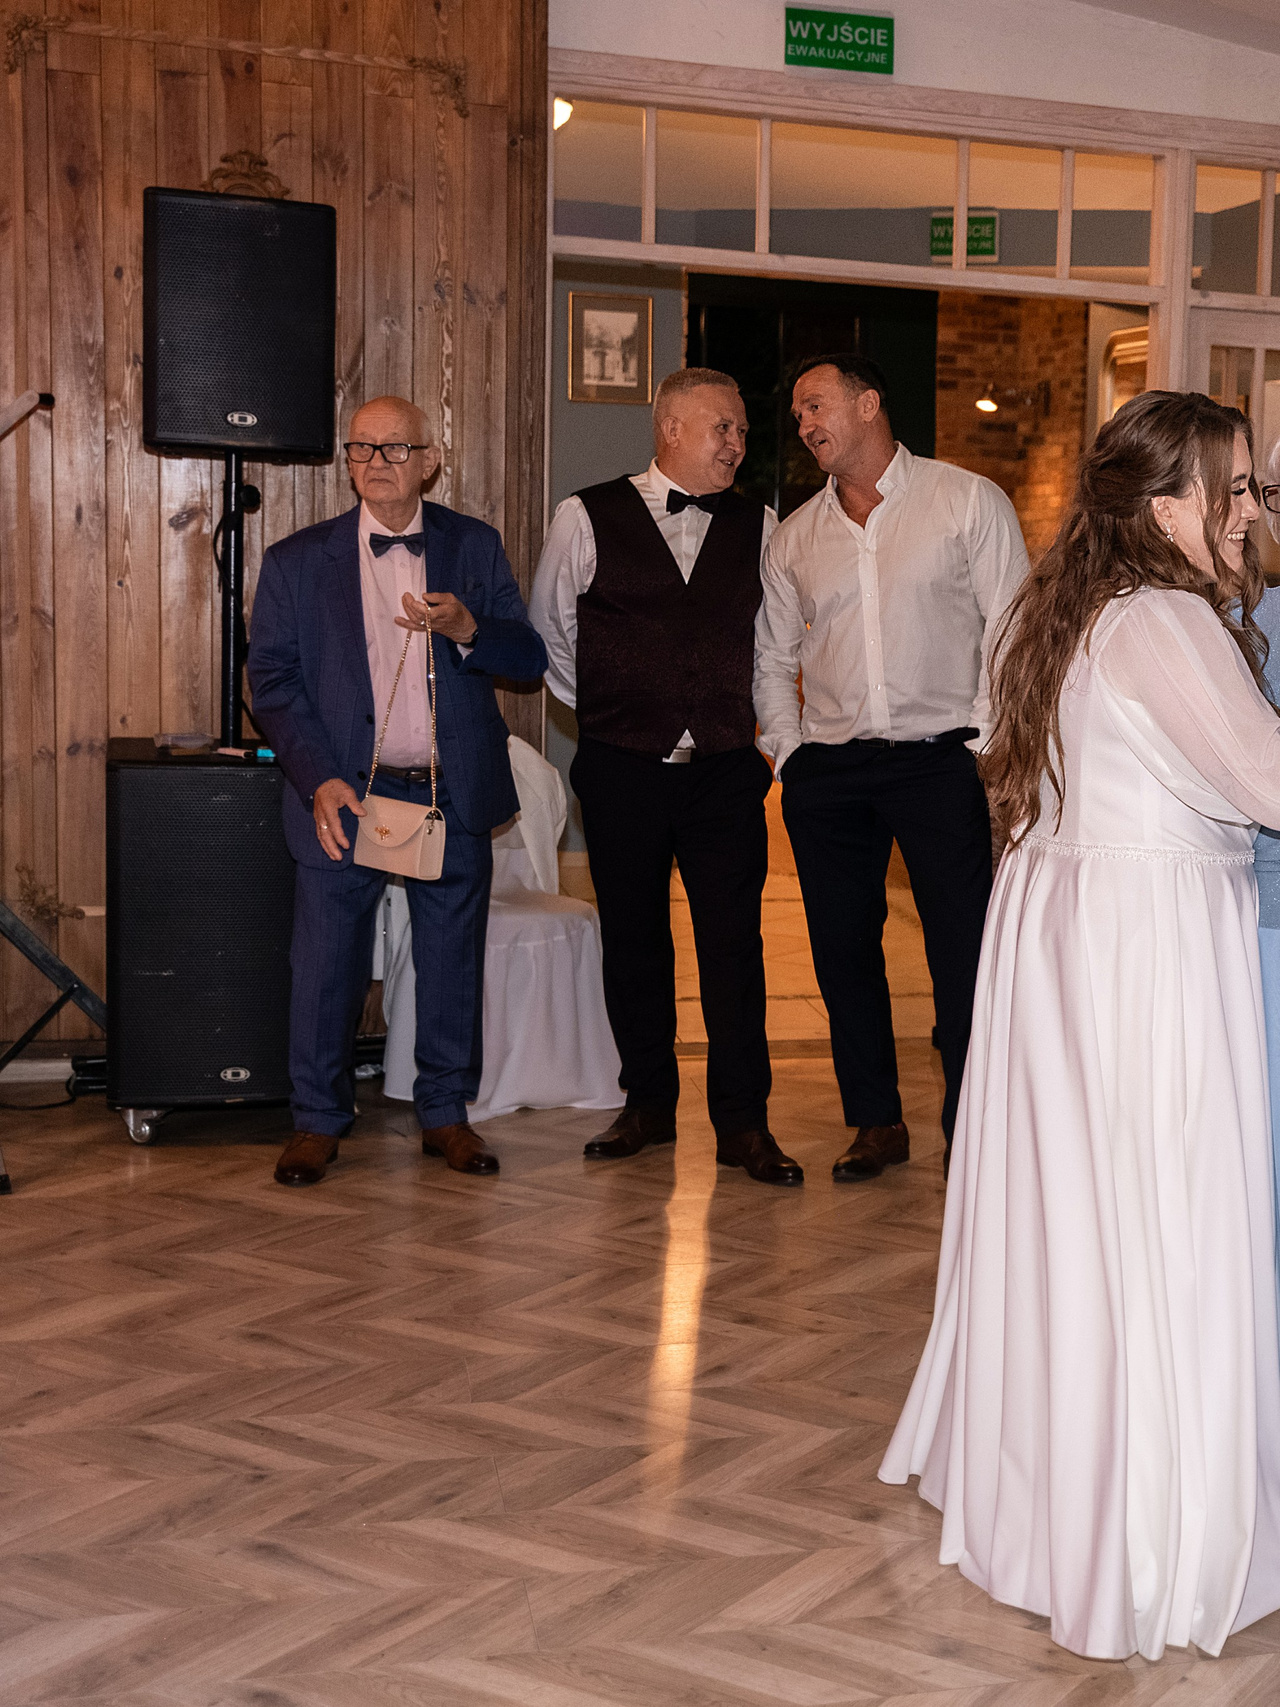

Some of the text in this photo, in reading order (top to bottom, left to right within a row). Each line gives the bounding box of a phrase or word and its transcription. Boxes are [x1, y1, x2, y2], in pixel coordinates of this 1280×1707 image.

[789, 20, 888, 47] WYJŚCIE
[787, 44, 888, 64] EWAKUACYJNE
[933, 224, 993, 238] WYCIE
